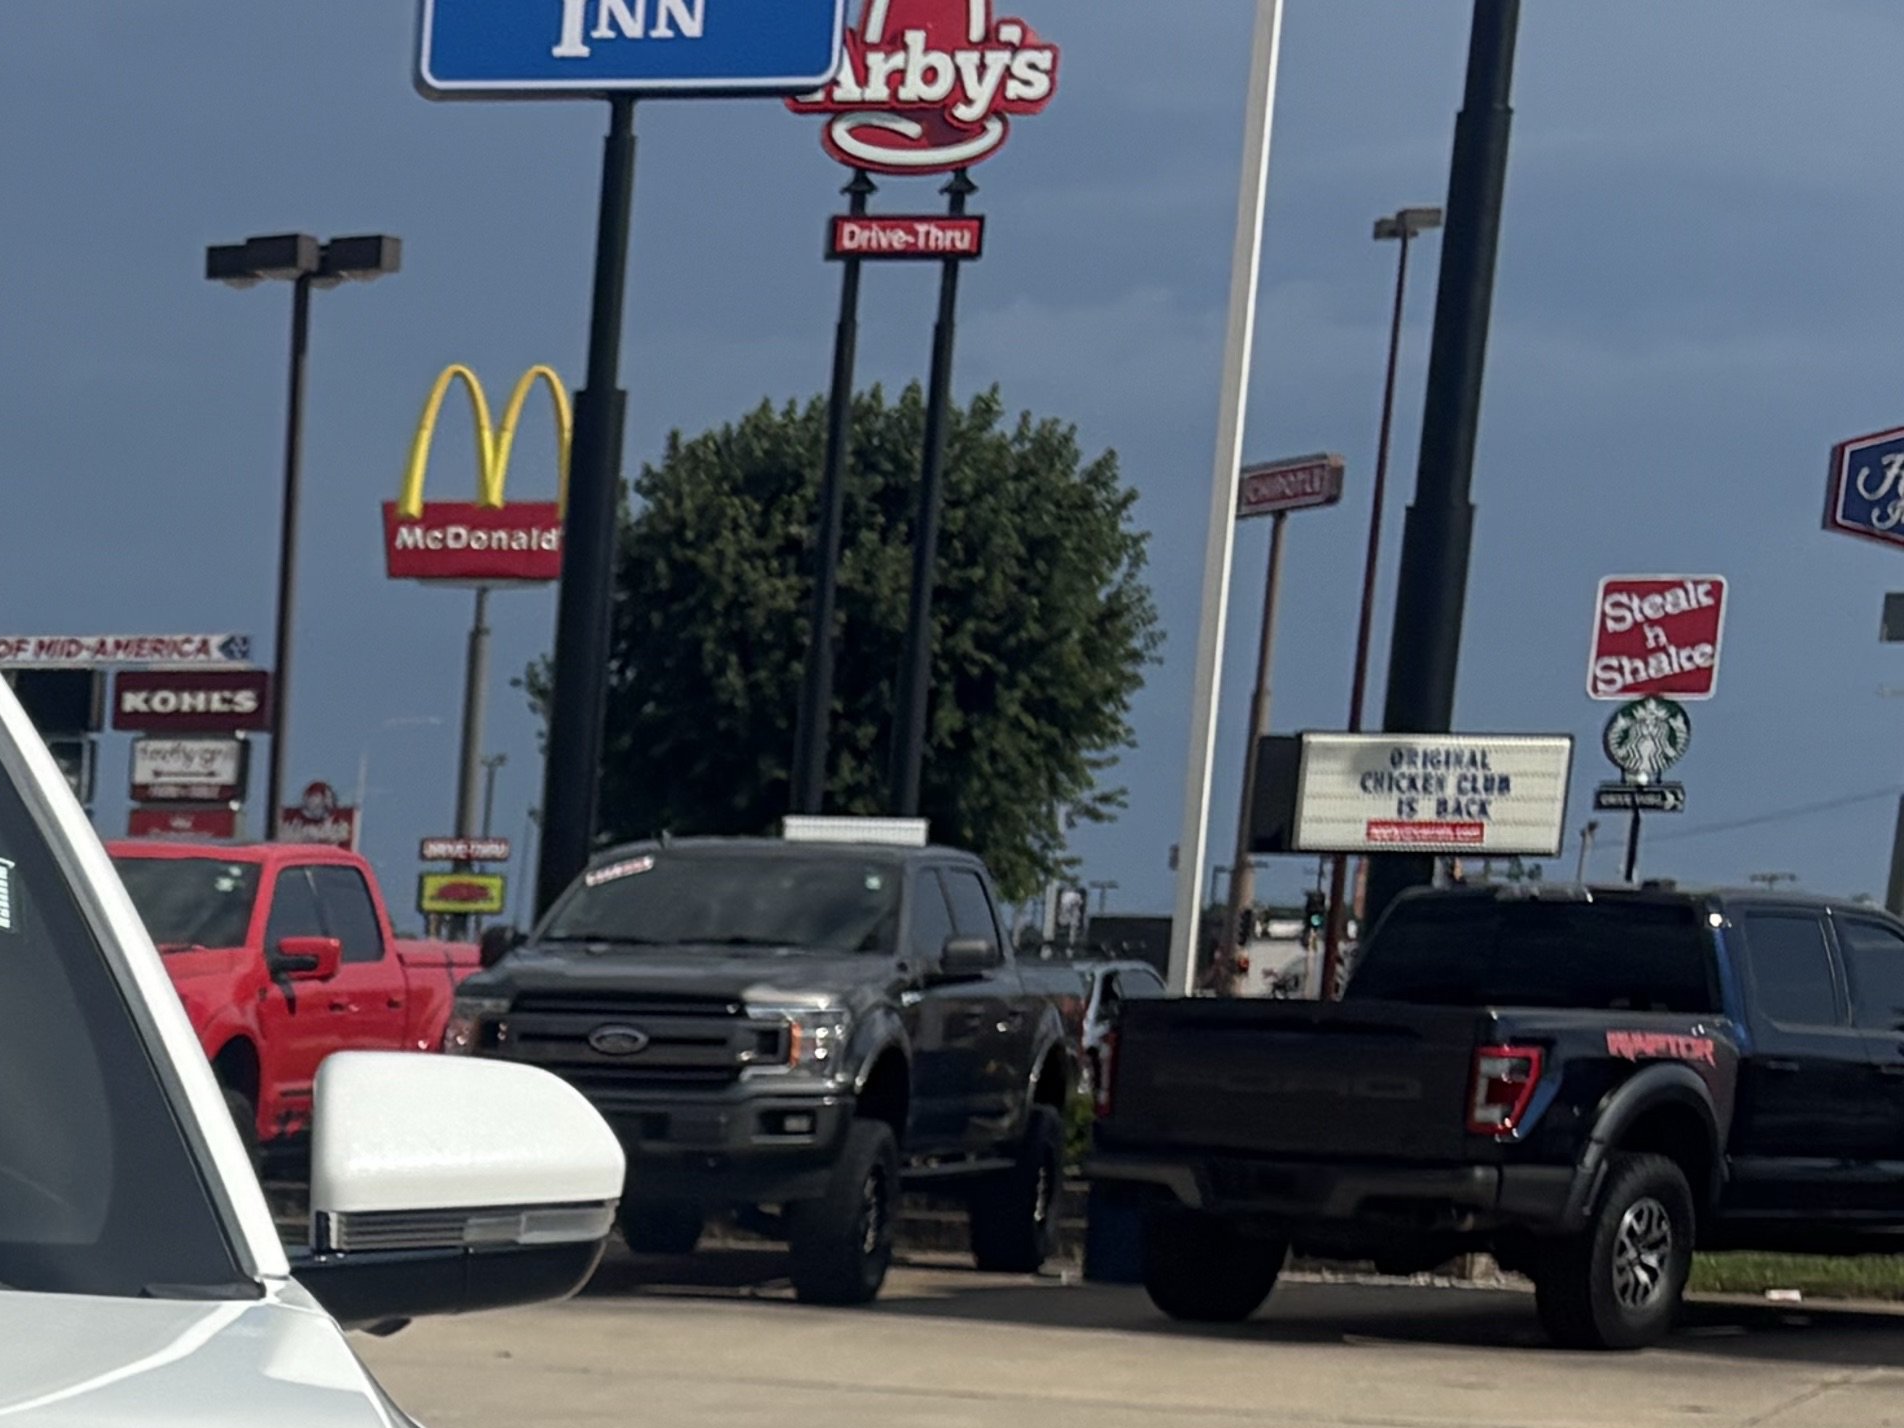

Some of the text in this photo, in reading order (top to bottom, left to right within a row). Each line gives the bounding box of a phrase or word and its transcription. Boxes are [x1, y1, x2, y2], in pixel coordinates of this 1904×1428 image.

[551, 0, 705, 58] INN
[840, 221, 973, 251] Drive-Thru
[1603, 580, 1715, 634] Steak
[34, 636, 213, 659] MID-AMERICA
[1594, 642, 1716, 694] Shake
[1390, 747, 1492, 771] ORIGINAL
[1359, 772, 1512, 796] CHICKEN CLUB
[1397, 797, 1491, 821] IS BACK
[1605, 1030, 1717, 1069] RAPTOR
